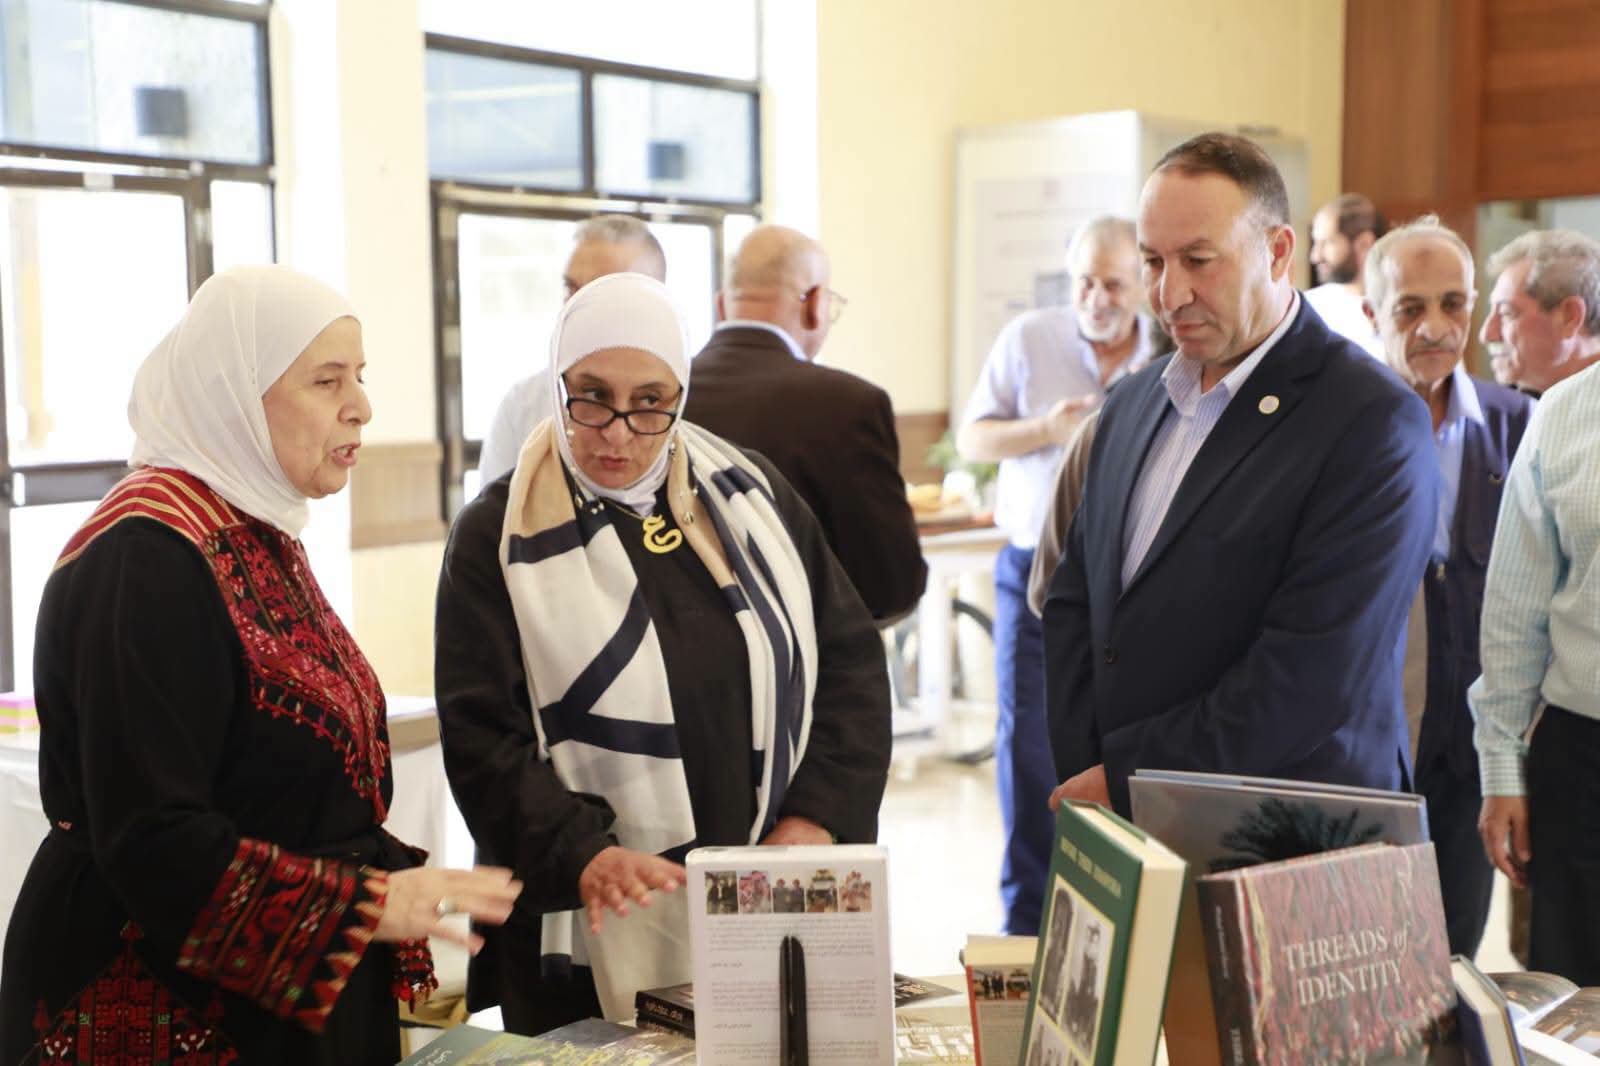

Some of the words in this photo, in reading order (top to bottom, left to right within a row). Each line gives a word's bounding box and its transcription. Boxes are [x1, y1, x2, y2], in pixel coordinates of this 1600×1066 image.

[1283, 926, 1388, 972] THREADS
[1393, 921, 1412, 954] of
[1297, 959, 1402, 1006] IDENTITY
